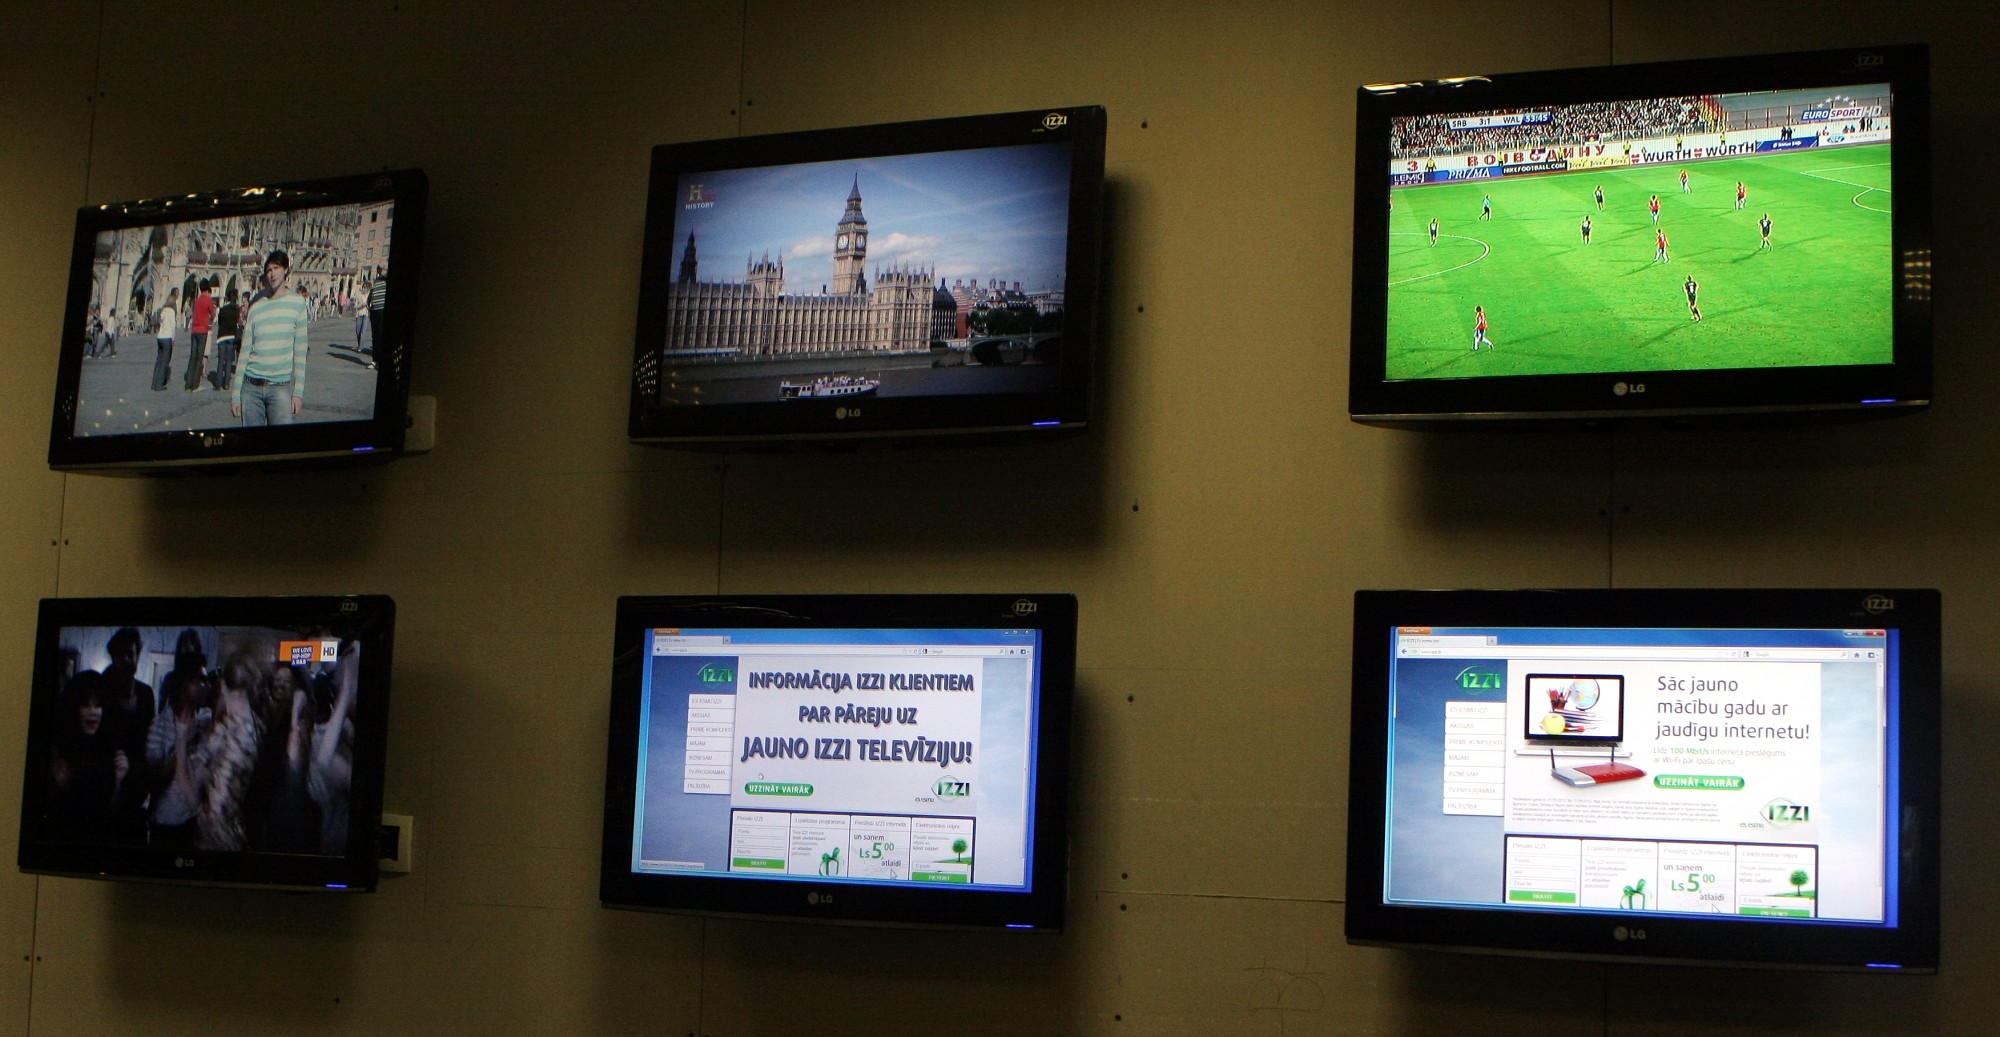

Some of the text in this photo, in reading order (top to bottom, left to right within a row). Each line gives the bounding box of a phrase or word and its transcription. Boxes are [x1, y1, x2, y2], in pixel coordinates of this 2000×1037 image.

[1047, 116, 1067, 125] IZZI
[1479, 118, 1491, 126] 3:1
[1503, 116, 1520, 124] WAL
[1525, 114, 1548, 122] 53:45
[1448, 167, 1491, 180] PRIZMA
[686, 201, 715, 210] HISTORY
[1016, 602, 1037, 612] IZZI
[1867, 599, 1894, 609] IZZI
[323, 646, 335, 656] HD
[703, 668, 733, 682] IZZI
[748, 669, 974, 693] INFORMĀCIJA IZZI KLIENTIEM
[1462, 672, 1501, 689] IZZI
[1657, 676, 1738, 695] Sāc jauno
[1657, 698, 1788, 719] mācību gadu ar
[798, 703, 918, 727] PAR PĀREJU UZ
[1655, 721, 1810, 742] jaudīgu internetu!
[740, 736, 973, 768] JAUNO IZZI TELEVĪZIJU!
[1662, 756, 1681, 764] Wi-Fi
[1659, 777, 1739, 788] UZZINĀT VAIRĀK
[749, 783, 809, 795] UZZINĀT VAIRĀK
[937, 782, 970, 797] IZZI
[1769, 805, 1810, 822] IZZI
[859, 848, 870, 859] Ls
[881, 859, 901, 867] atlaidi
[1675, 864, 1703, 872] saņem
[1671, 880, 1684, 891] Ls
[1699, 893, 1724, 902] atlaidi
